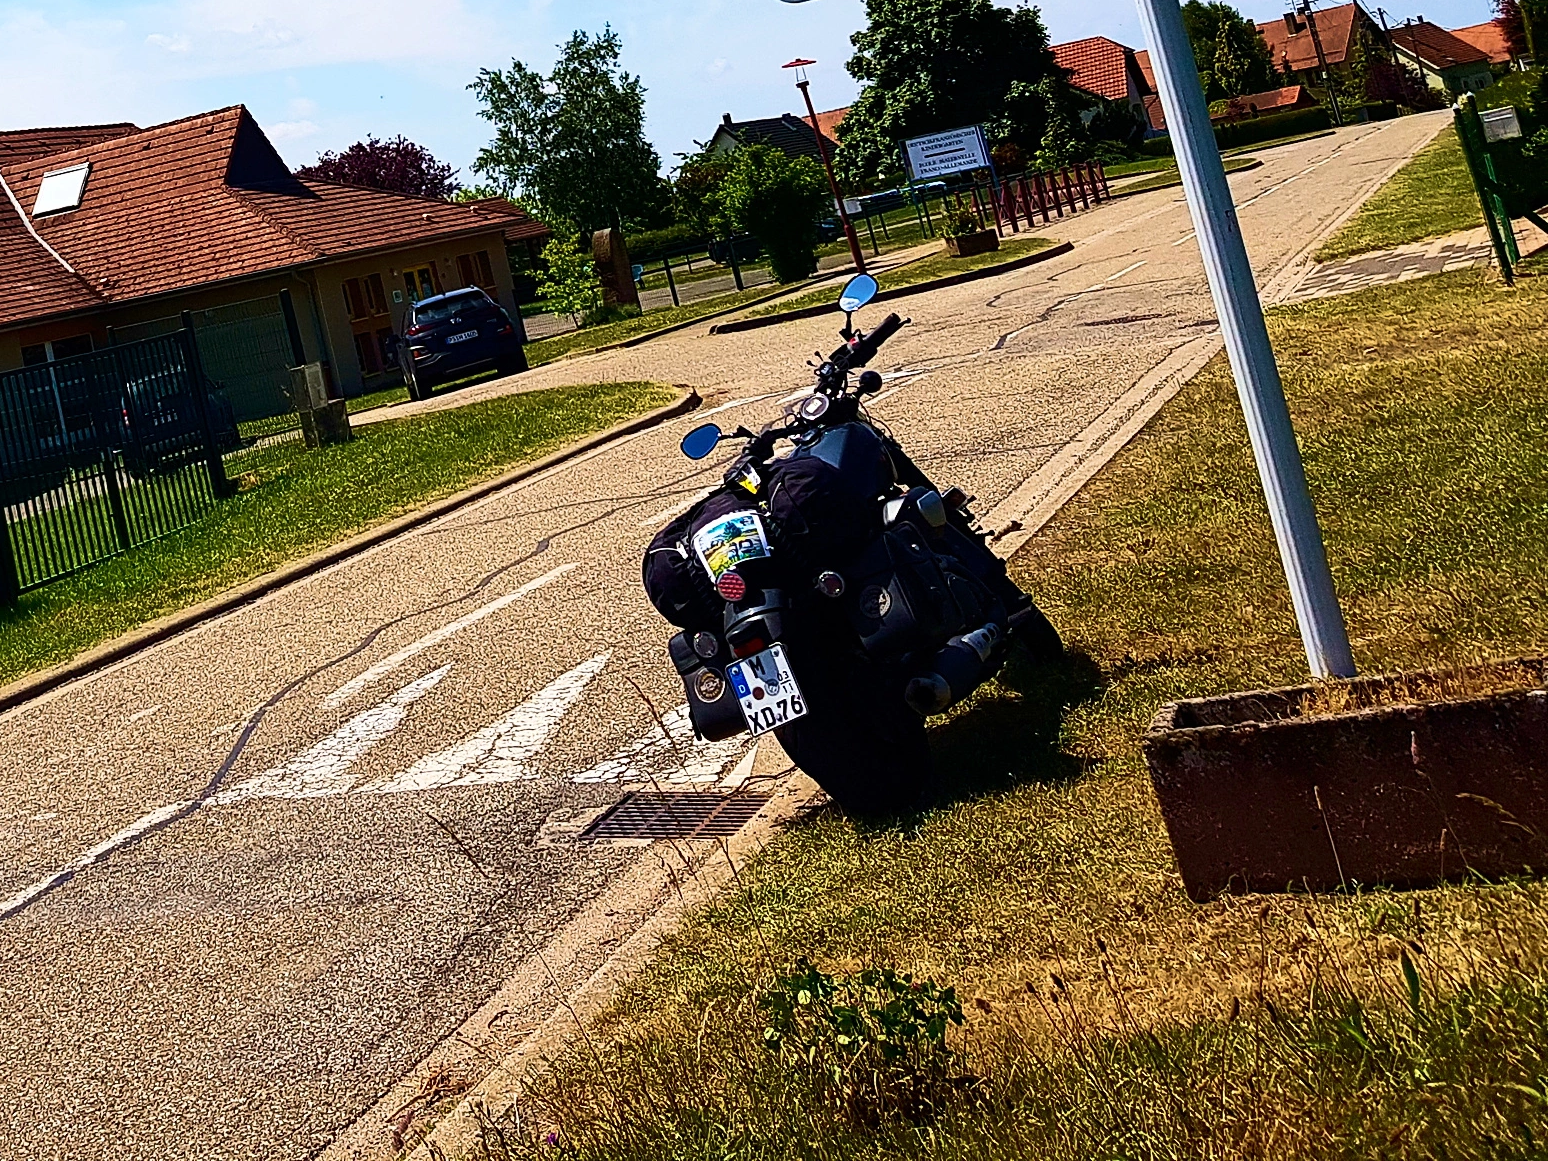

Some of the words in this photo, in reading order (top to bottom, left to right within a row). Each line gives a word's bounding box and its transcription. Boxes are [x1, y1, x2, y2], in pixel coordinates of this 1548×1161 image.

[748, 655, 766, 679] M
[738, 684, 746, 694] D
[748, 706, 777, 734] XD
[776, 695, 804, 721] 76
